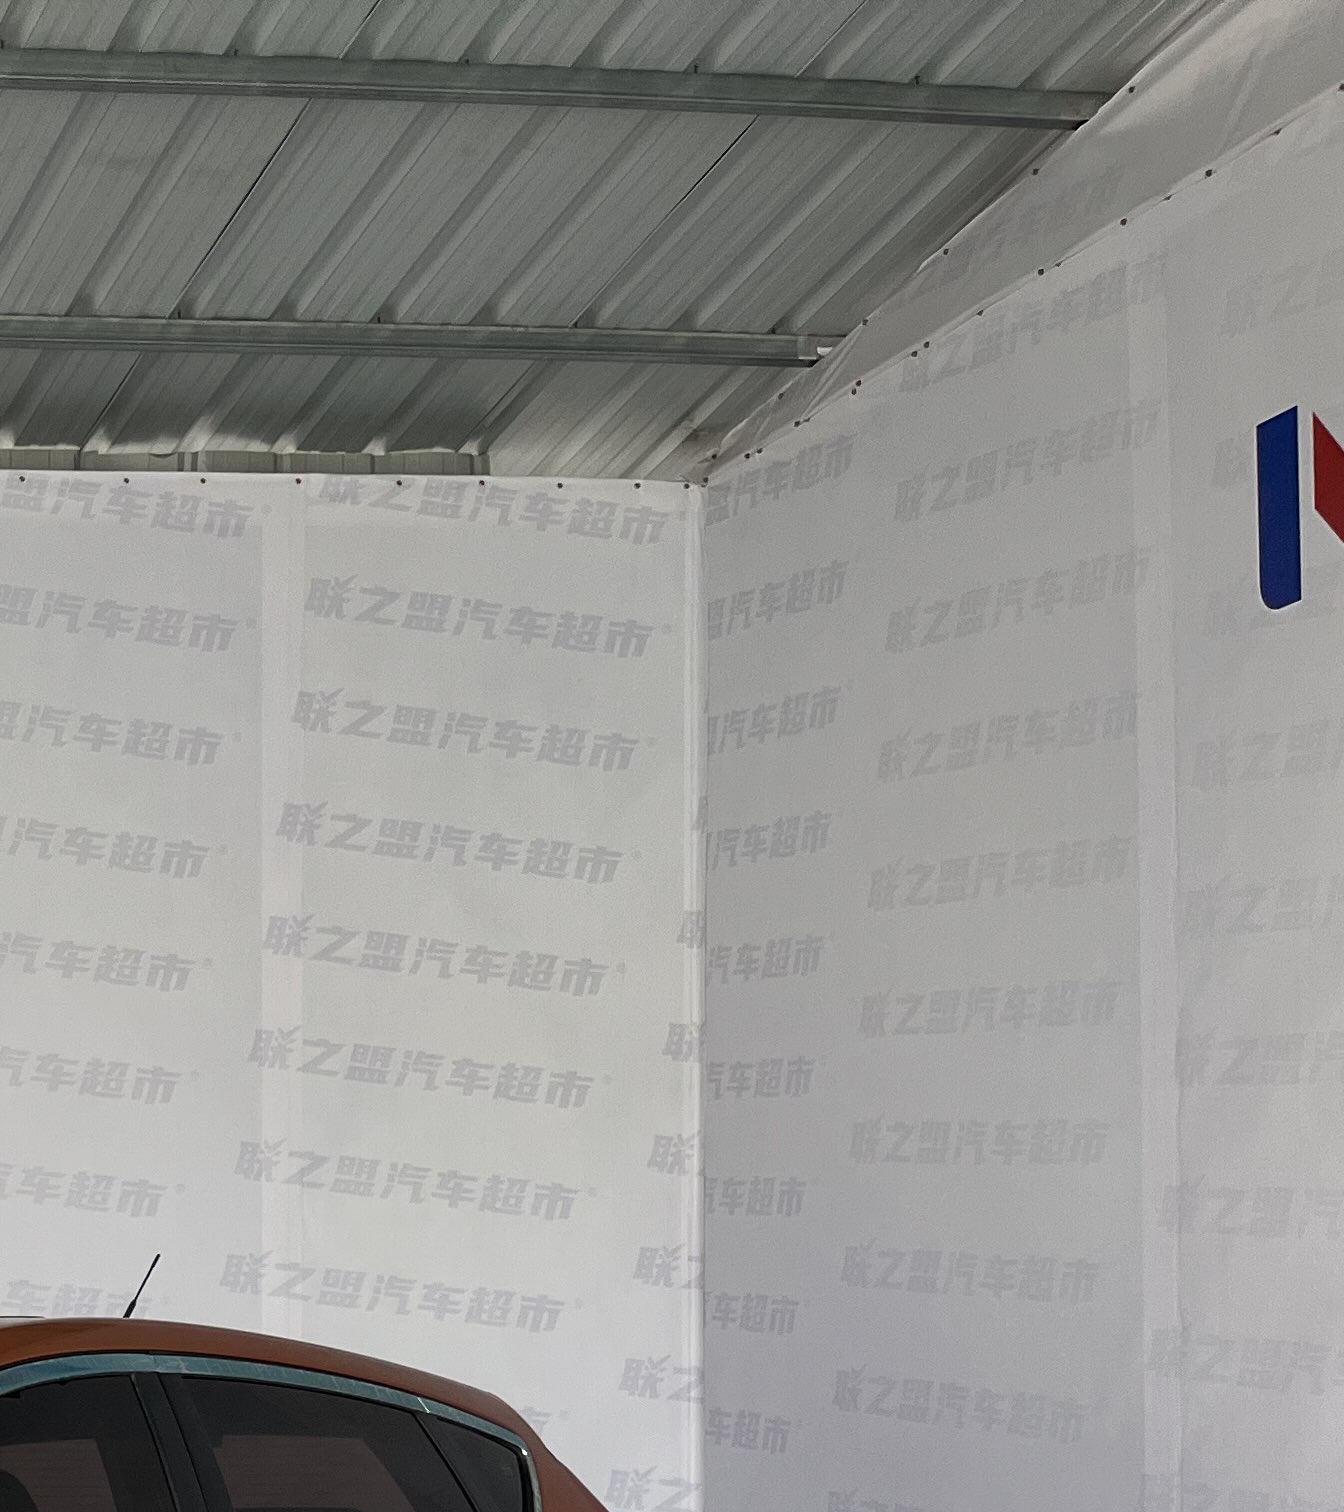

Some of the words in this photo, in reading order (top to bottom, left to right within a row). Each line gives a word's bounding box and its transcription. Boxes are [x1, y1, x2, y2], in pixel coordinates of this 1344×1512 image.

[894, 399, 1161, 522] 联之盟汽车超市
[304, 575, 652, 658] 联之盟汽车超市
[885, 546, 1151, 653] 联之盟汽车超市
[290, 686, 638, 772] 联之盟汽车超市
[877, 692, 1142, 783] 联之盟汽车超市
[277, 799, 623, 884] 联之盟汽车超市
[869, 835, 1135, 911] 联之盟汽车超市
[264, 913, 607, 997] 联之盟汽车超市
[859, 978, 1122, 1037] 联之盟汽车超市
[248, 1026, 594, 1110] 联之盟汽车超市
[234, 1138, 579, 1221] 联之盟汽车超市
[850, 1113, 1109, 1165] 联之盟汽车超市
[219, 1251, 563, 1335] 联之盟汽车超市
[842, 1238, 1100, 1303] 联之盟汽车超市
[832, 1365, 1089, 1445] 联之盟汽车超市
